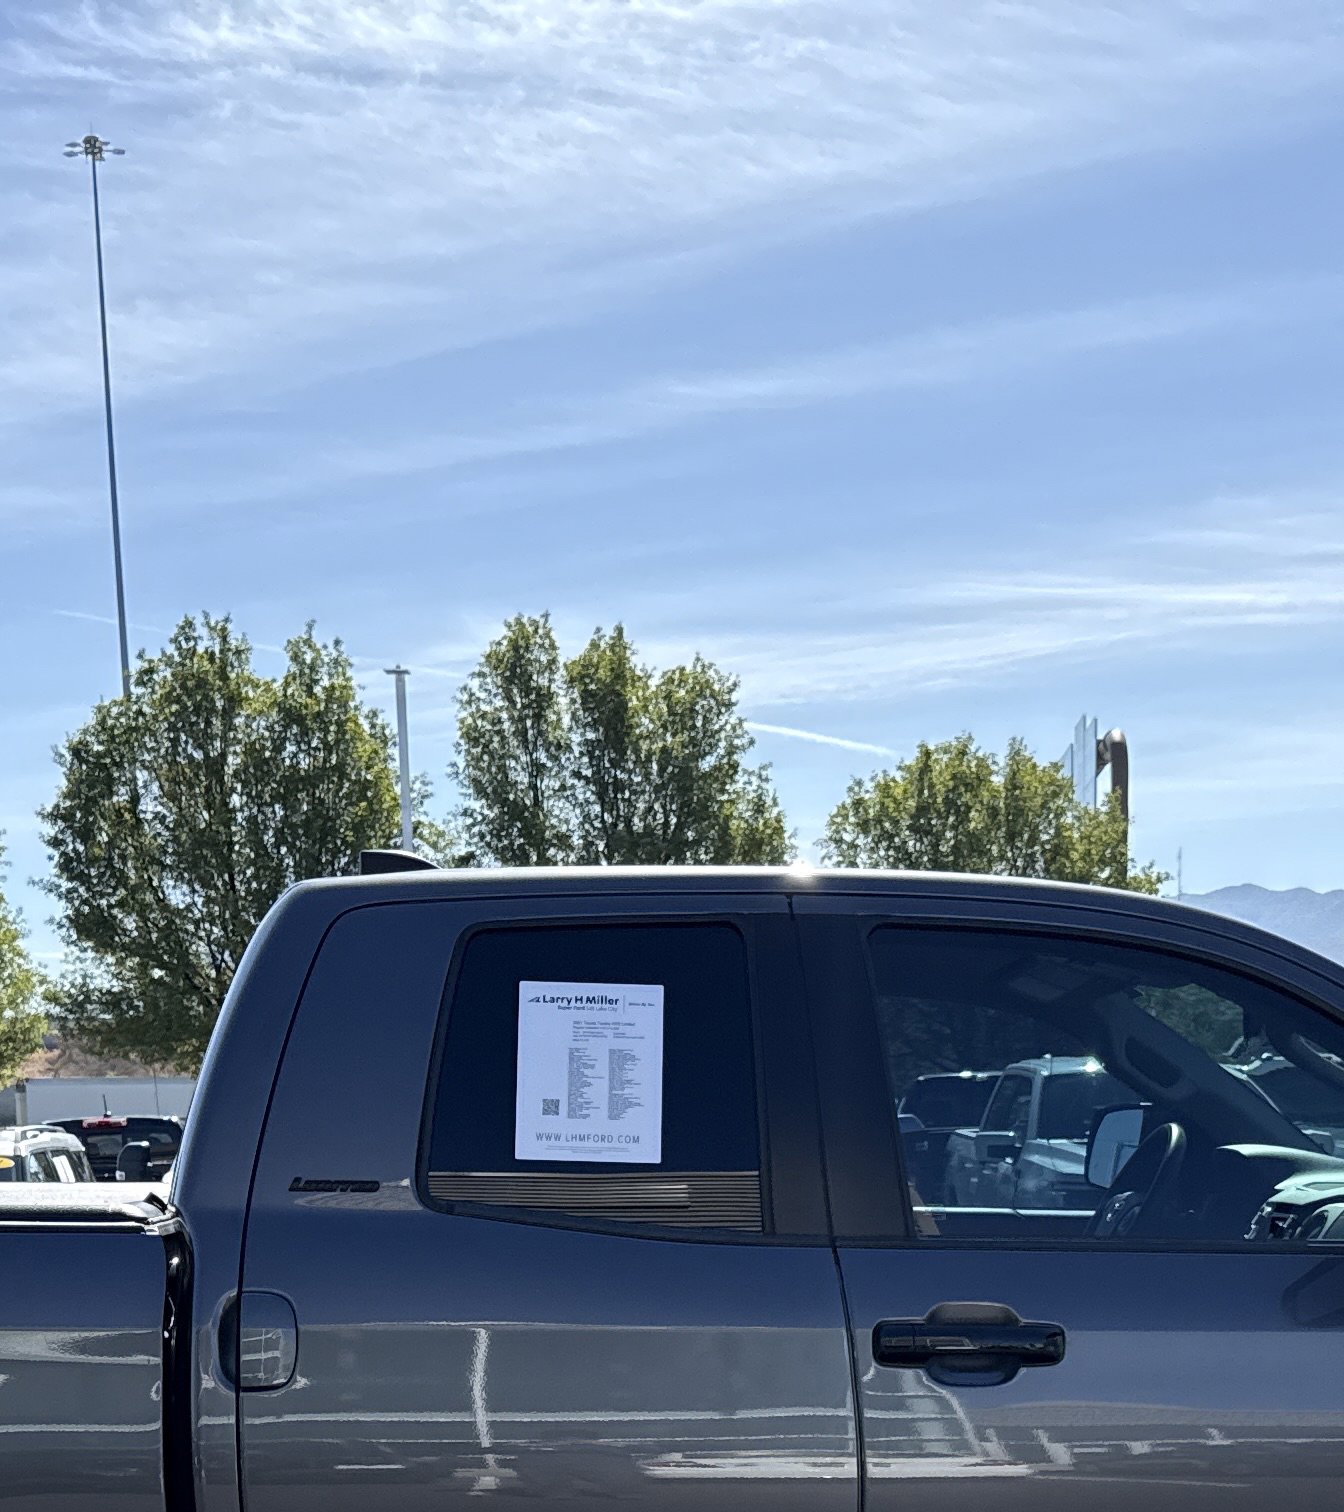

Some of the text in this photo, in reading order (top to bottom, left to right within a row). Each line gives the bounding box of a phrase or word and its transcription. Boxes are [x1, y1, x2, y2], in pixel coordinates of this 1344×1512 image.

[543, 995, 573, 1006] Larry
[575, 995, 584, 1005] H
[585, 995, 620, 1006] Miller
